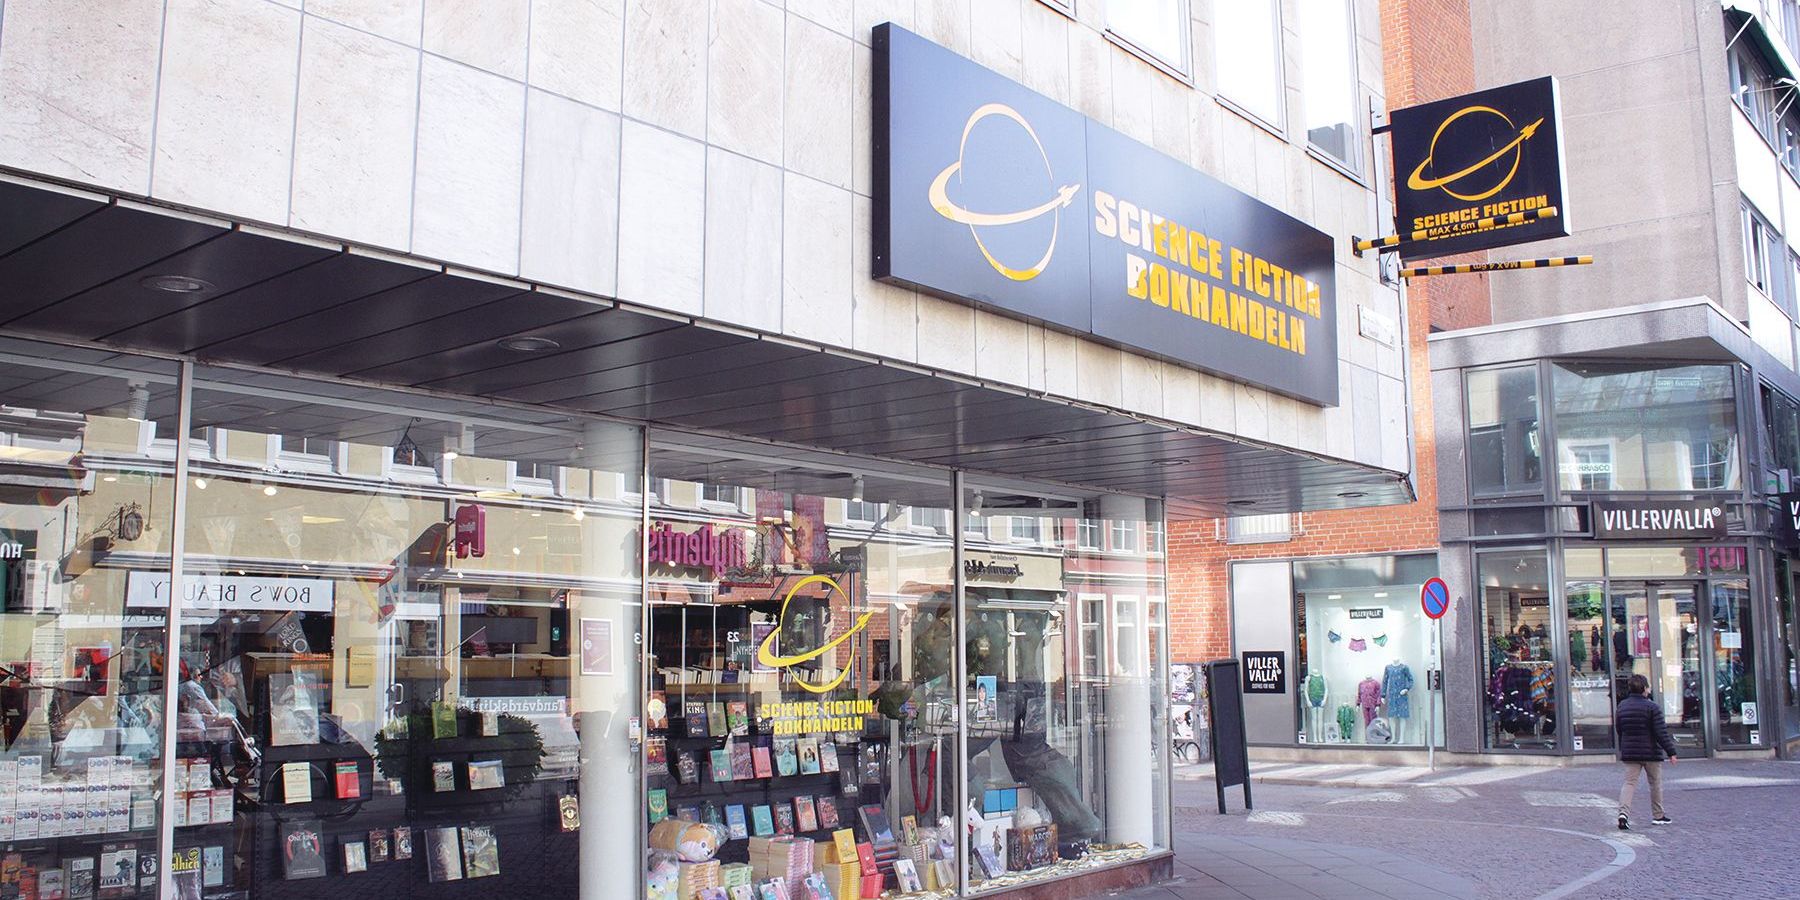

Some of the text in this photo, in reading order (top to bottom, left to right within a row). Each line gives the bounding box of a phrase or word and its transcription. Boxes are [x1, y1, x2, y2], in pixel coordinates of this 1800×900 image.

[1413, 195, 1548, 230] SCIENCE FICTION
[1429, 225, 1451, 237] MAX
[1094, 190, 1321, 320] SCIENCE FICTION
[1127, 253, 1306, 356] BOKHANDELN
[1247, 656, 1279, 669] VILLER
[1249, 669, 1278, 682] VALLA
[686, 706, 705, 714] KING
[761, 700, 873, 718] SCIENCE FICTION
[773, 716, 863, 735] BOKHANDELN
